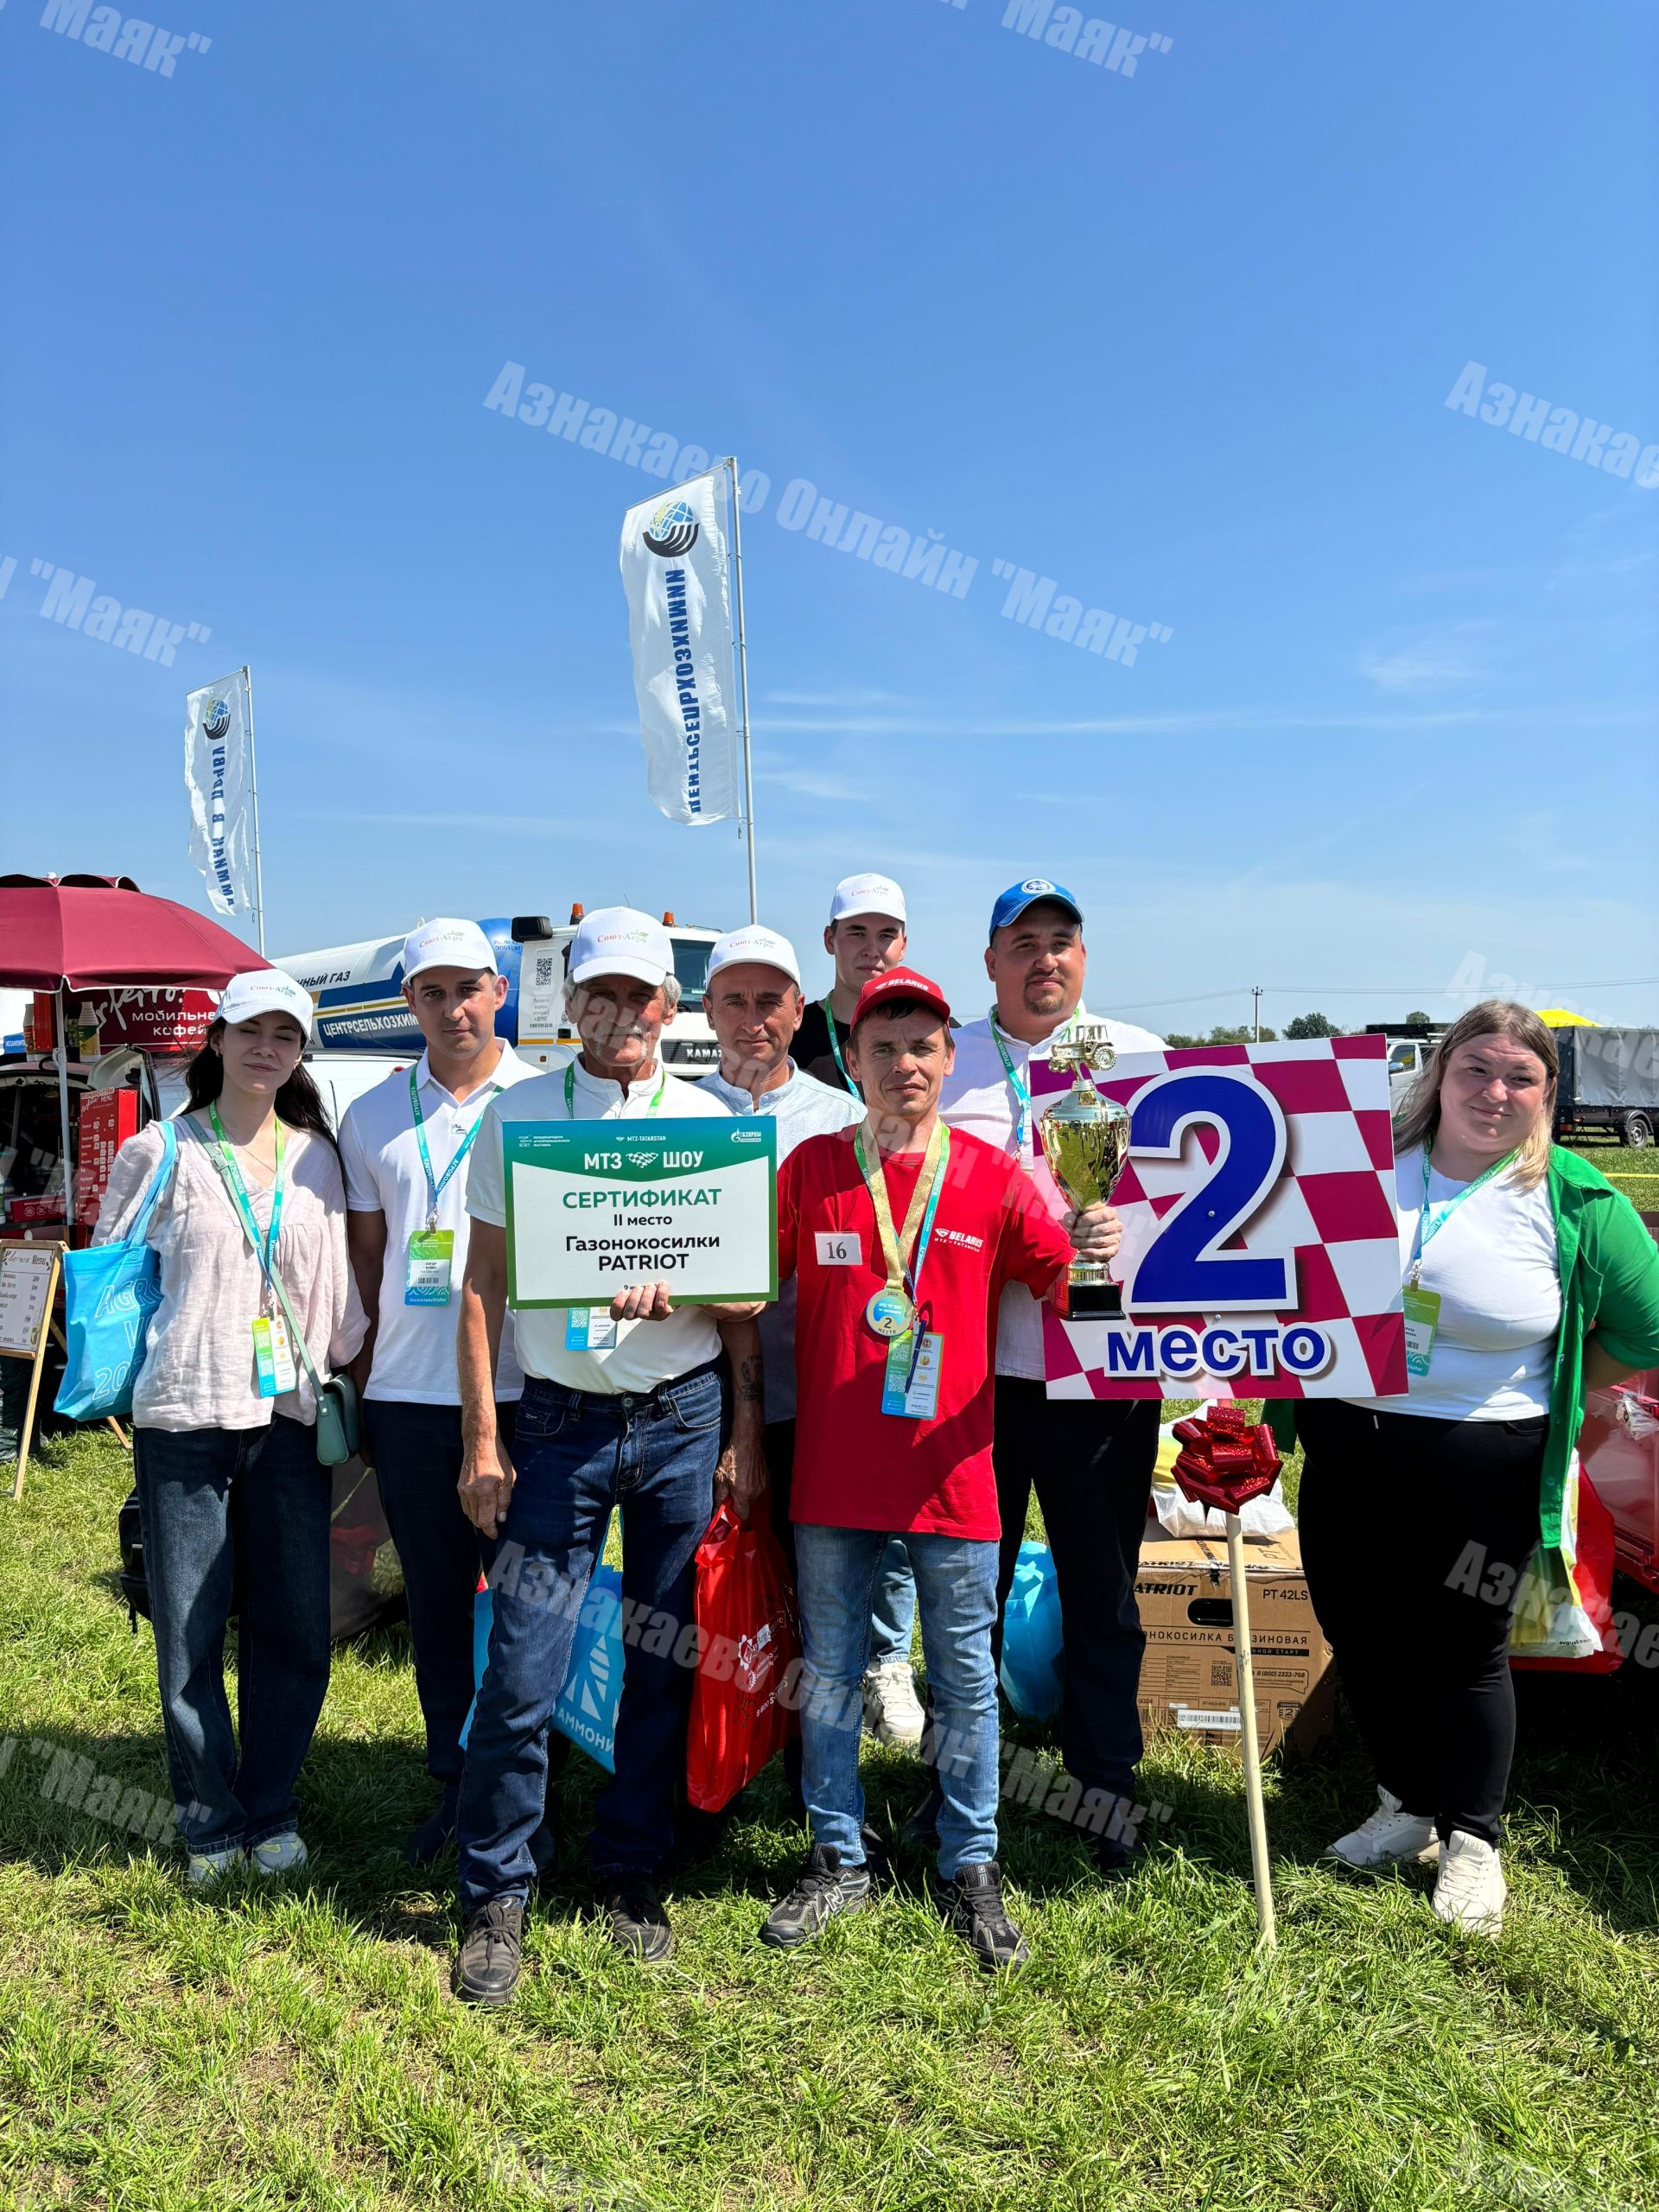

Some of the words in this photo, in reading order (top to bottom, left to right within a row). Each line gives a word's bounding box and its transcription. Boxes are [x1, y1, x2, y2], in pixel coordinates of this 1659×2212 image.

[329, 970, 351, 982] ГАЗ
[887, 977, 930, 992] BELARUS
[410, 1086, 421, 1116] АГРОВОЛГА
[584, 1152, 622, 1170] МТЗ
[663, 1151, 703, 1168] ШОУ
[1128, 1071, 1294, 1306] 2
[563, 1188, 721, 1209] СЕРТИФИКАТ
[627, 1215, 672, 1226] место
[566, 1235, 720, 1252] Газонокосилки
[949, 1230, 984, 1248] BELARUS
[826, 1241, 848, 1260] 16
[599, 1253, 690, 1272] PATRIOT
[883, 1317, 893, 1329] 2
[1107, 1323, 1328, 1374] место
[1134, 1582, 1198, 1596] ATRIOT
[1262, 1589, 1279, 1599] PT
[1280, 1589, 1308, 1600] 42LS
[1228, 1631, 1307, 1645] БЗИНОВАЯ
[1284, 1708, 1294, 1719] 2
[557, 1707, 614, 1752] АММОНИ
